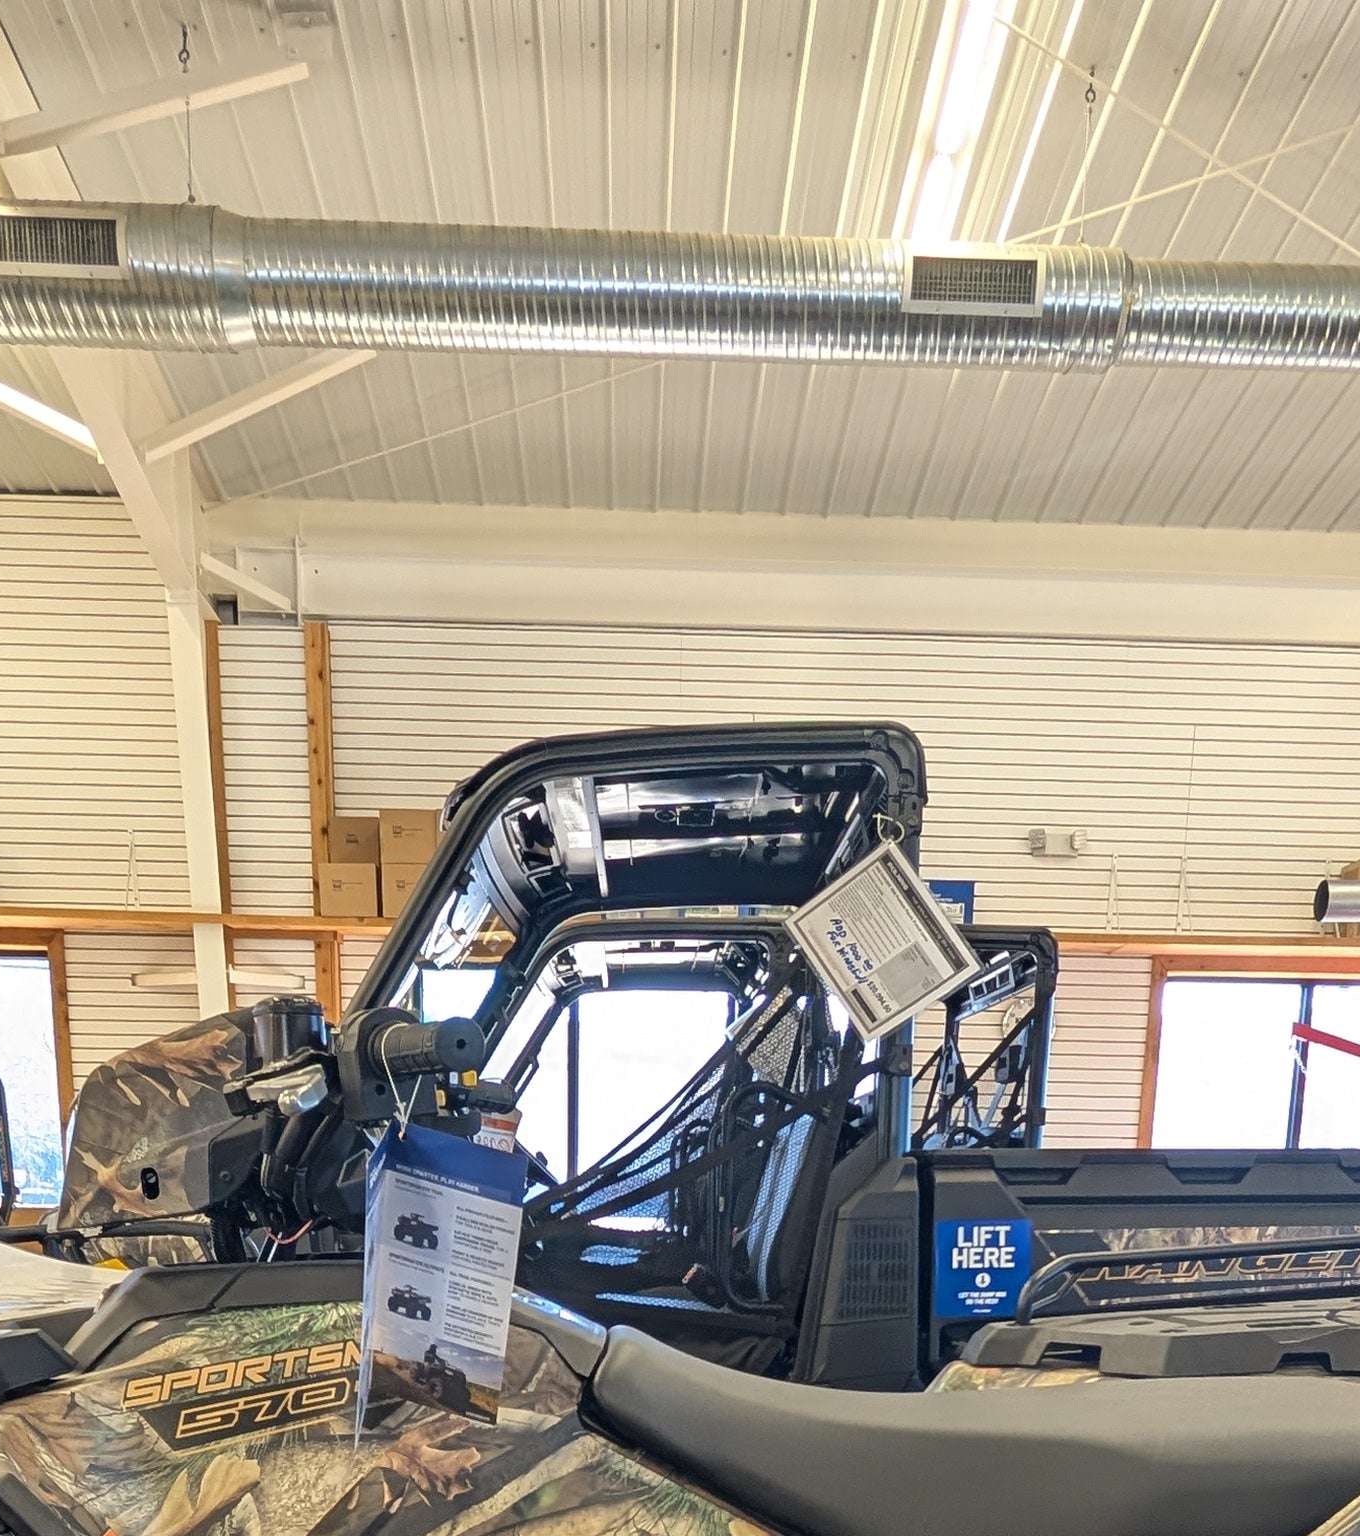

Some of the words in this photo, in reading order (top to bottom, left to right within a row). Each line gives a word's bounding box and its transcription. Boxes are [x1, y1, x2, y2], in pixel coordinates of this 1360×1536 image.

[828, 914, 850, 939] ADD
[957, 1226, 1011, 1247] LIFT
[952, 1247, 1016, 1269] HERE
[122, 1340, 362, 1411] SPORTSM
[176, 1376, 350, 1439] 570
